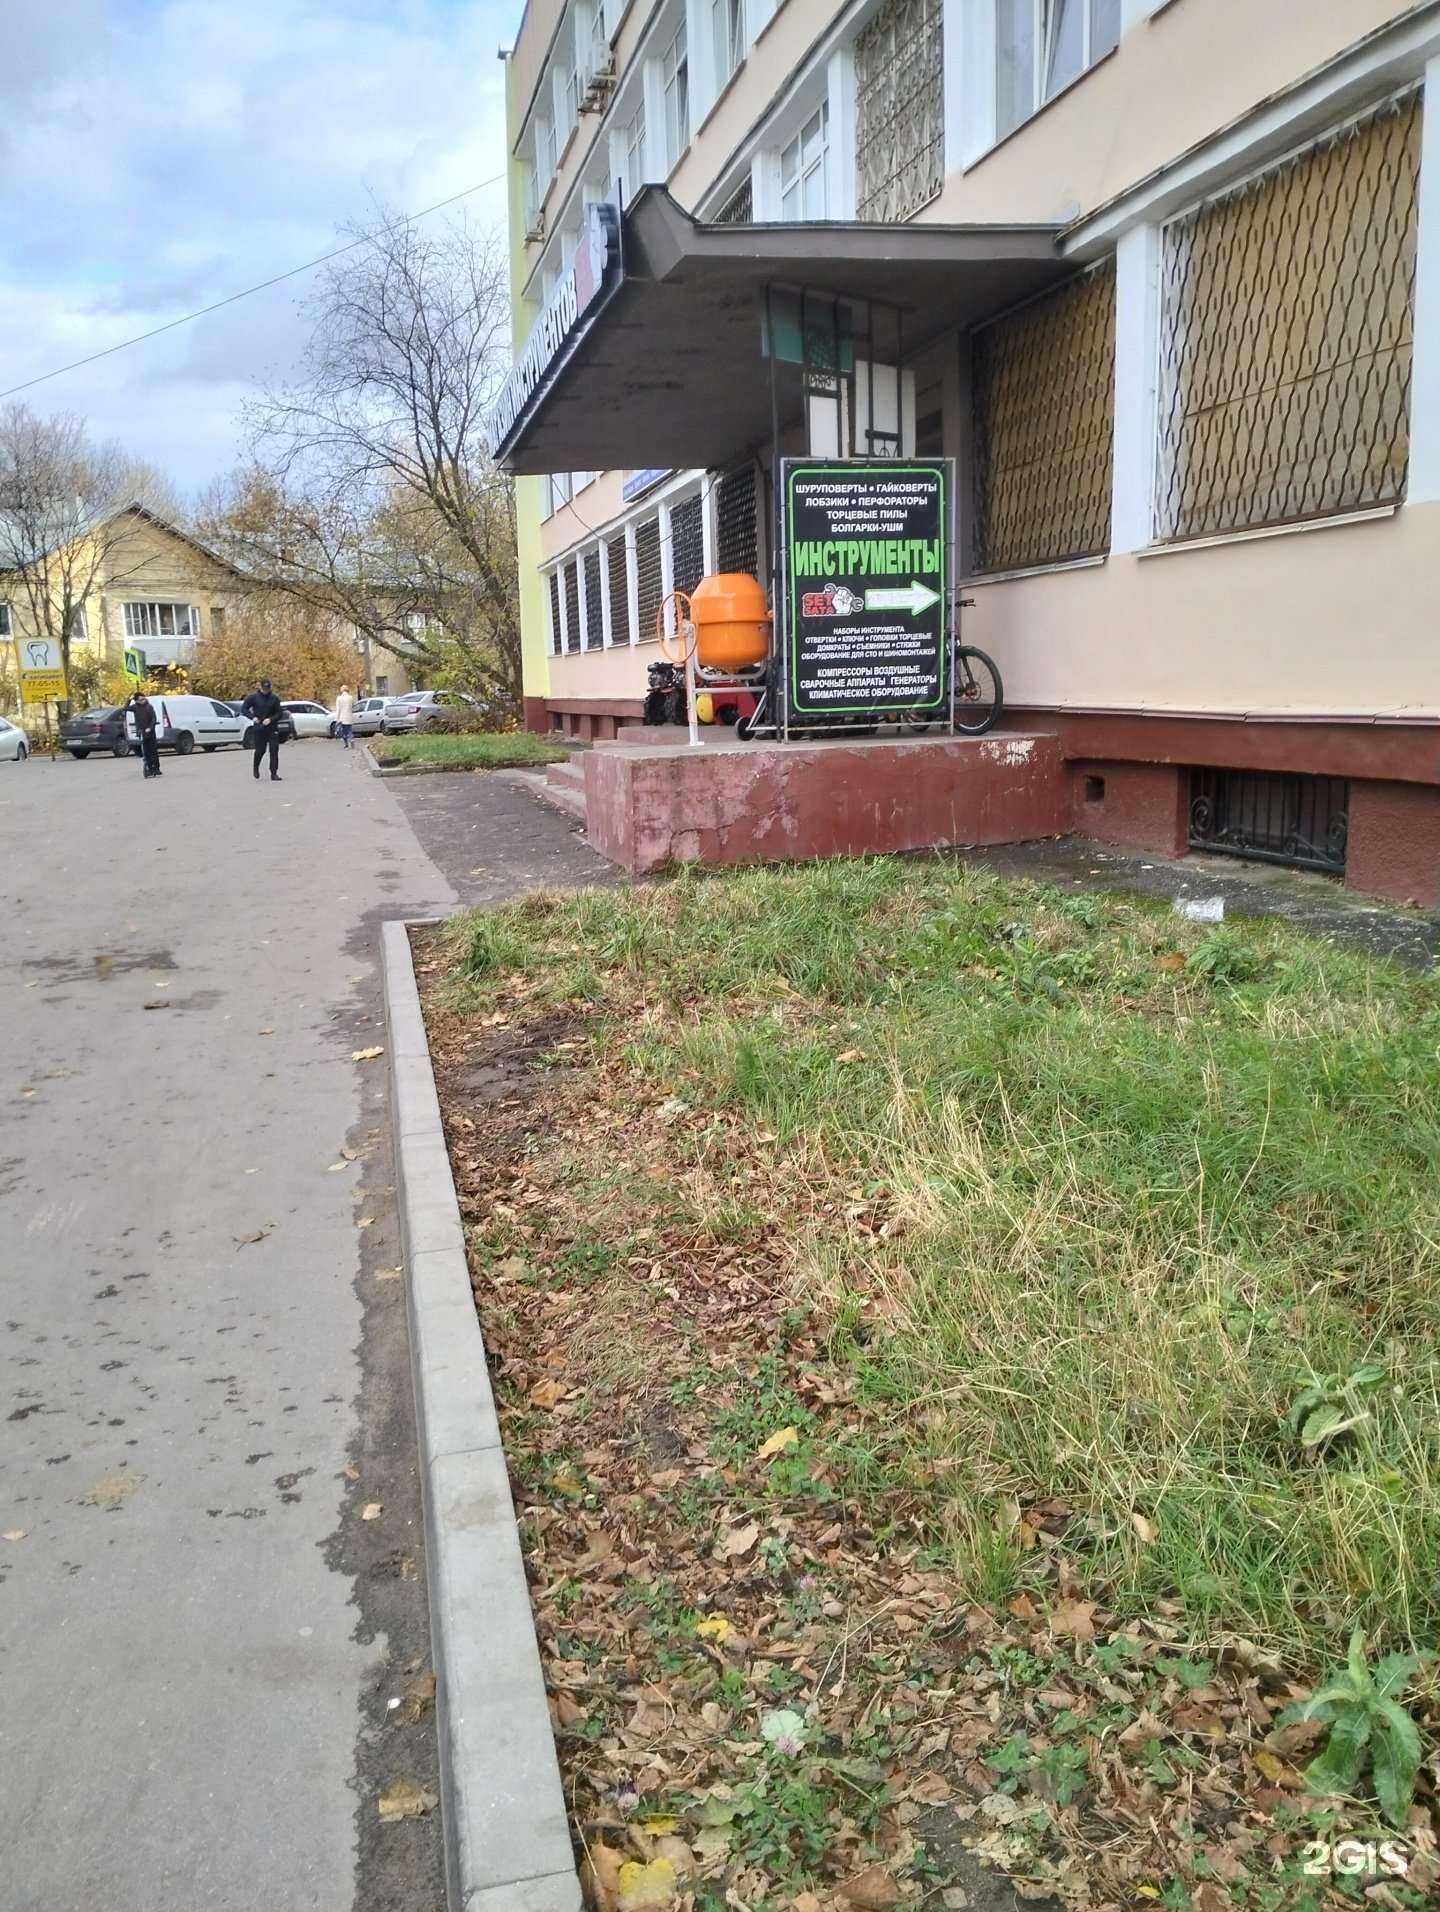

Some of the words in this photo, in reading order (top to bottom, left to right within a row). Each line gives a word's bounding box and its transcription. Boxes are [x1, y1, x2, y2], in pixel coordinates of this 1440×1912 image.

[795, 484, 867, 494] ШУРУПОВЕРТЫ
[876, 482, 937, 493] ГАЙКОВЕРТЫ
[805, 497, 849, 507] ЛОБЗИКИ
[858, 496, 928, 506] ПЕРФОРАТОРЫ
[826, 510, 878, 520] ТОРЦЕВЫЕ
[880, 509, 908, 519] ПИЛЫ
[831, 523, 904, 533] БОЛГАРКИ-УШМ
[795, 539, 940, 577] ИНСТРУМЕНТЫ
[805, 594, 833, 606] SET
[833, 626, 860, 635] НАБОРЫ
[861, 625, 905, 634] ИНСТРУМЕНТА
[805, 635, 837, 644] ОТВЕРТКИ
[842, 634, 865, 643] КЛЮЧИ
[870, 634, 898, 642] ГОЛОВКИ
[817, 643, 851, 652] ДОМКРАТЫ
[801, 651, 850, 660] ОБОРУДОВАНИЕ
[851, 650, 864, 659] ДЛЯ
[865, 650, 878, 658] СТО
[878, 649, 884, 658] И
[817, 667, 873, 677] КОМПРЕССОРЫ
[874, 665, 921, 675] ВОЗДУШНЫЕ
[800, 679, 845, 689] СВАРОЧНЫЕ
[847, 677, 886, 687] АППАРАТЫ
[890, 675, 937, 685] ГЕНЕРАТОРЫ
[809, 688, 870, 699] КЛИМАТИЧЕСКОЕ
[871, 685, 929, 697] ОБОРУДОВАНИЕ
